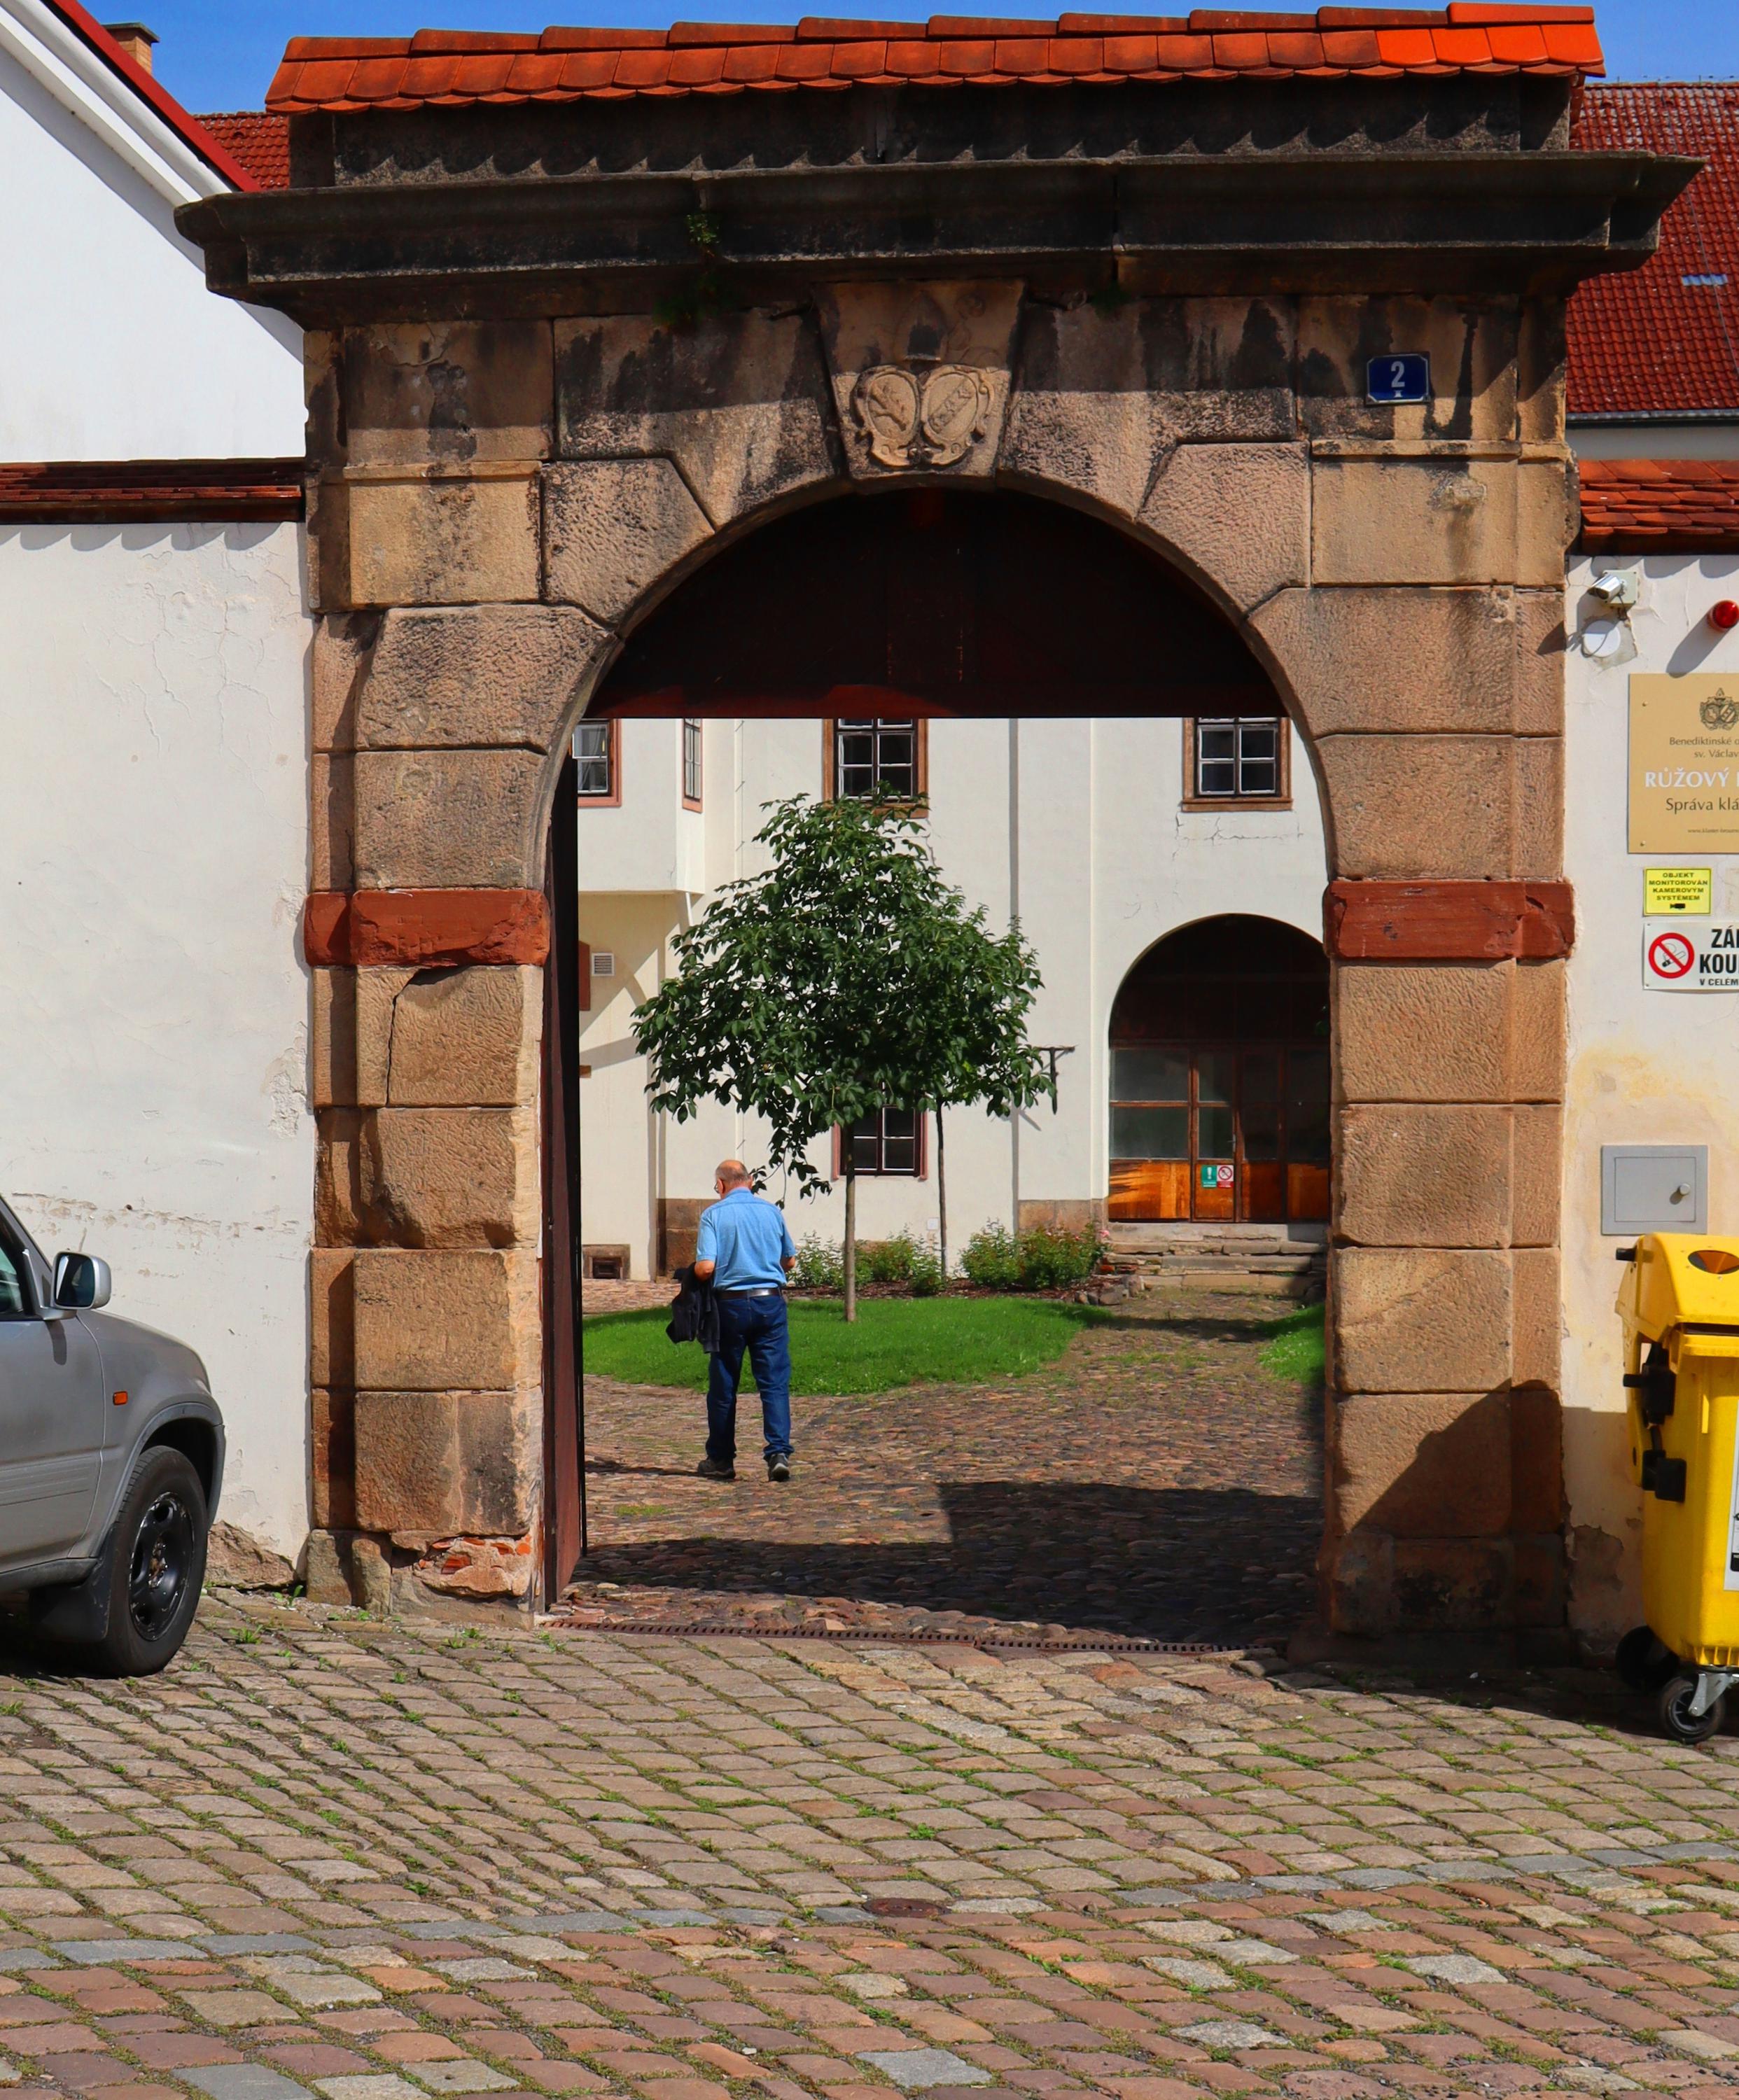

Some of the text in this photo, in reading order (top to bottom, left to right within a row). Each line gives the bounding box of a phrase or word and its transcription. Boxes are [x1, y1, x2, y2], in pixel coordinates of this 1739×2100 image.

[1390, 360, 1405, 388] 2
[1669, 737, 1732, 746] Benediktinské
[1645, 766, 1729, 788] RŮŽOVÝ
[1665, 797, 1714, 815] Správa
[1711, 925, 1739, 948] ZÁ
